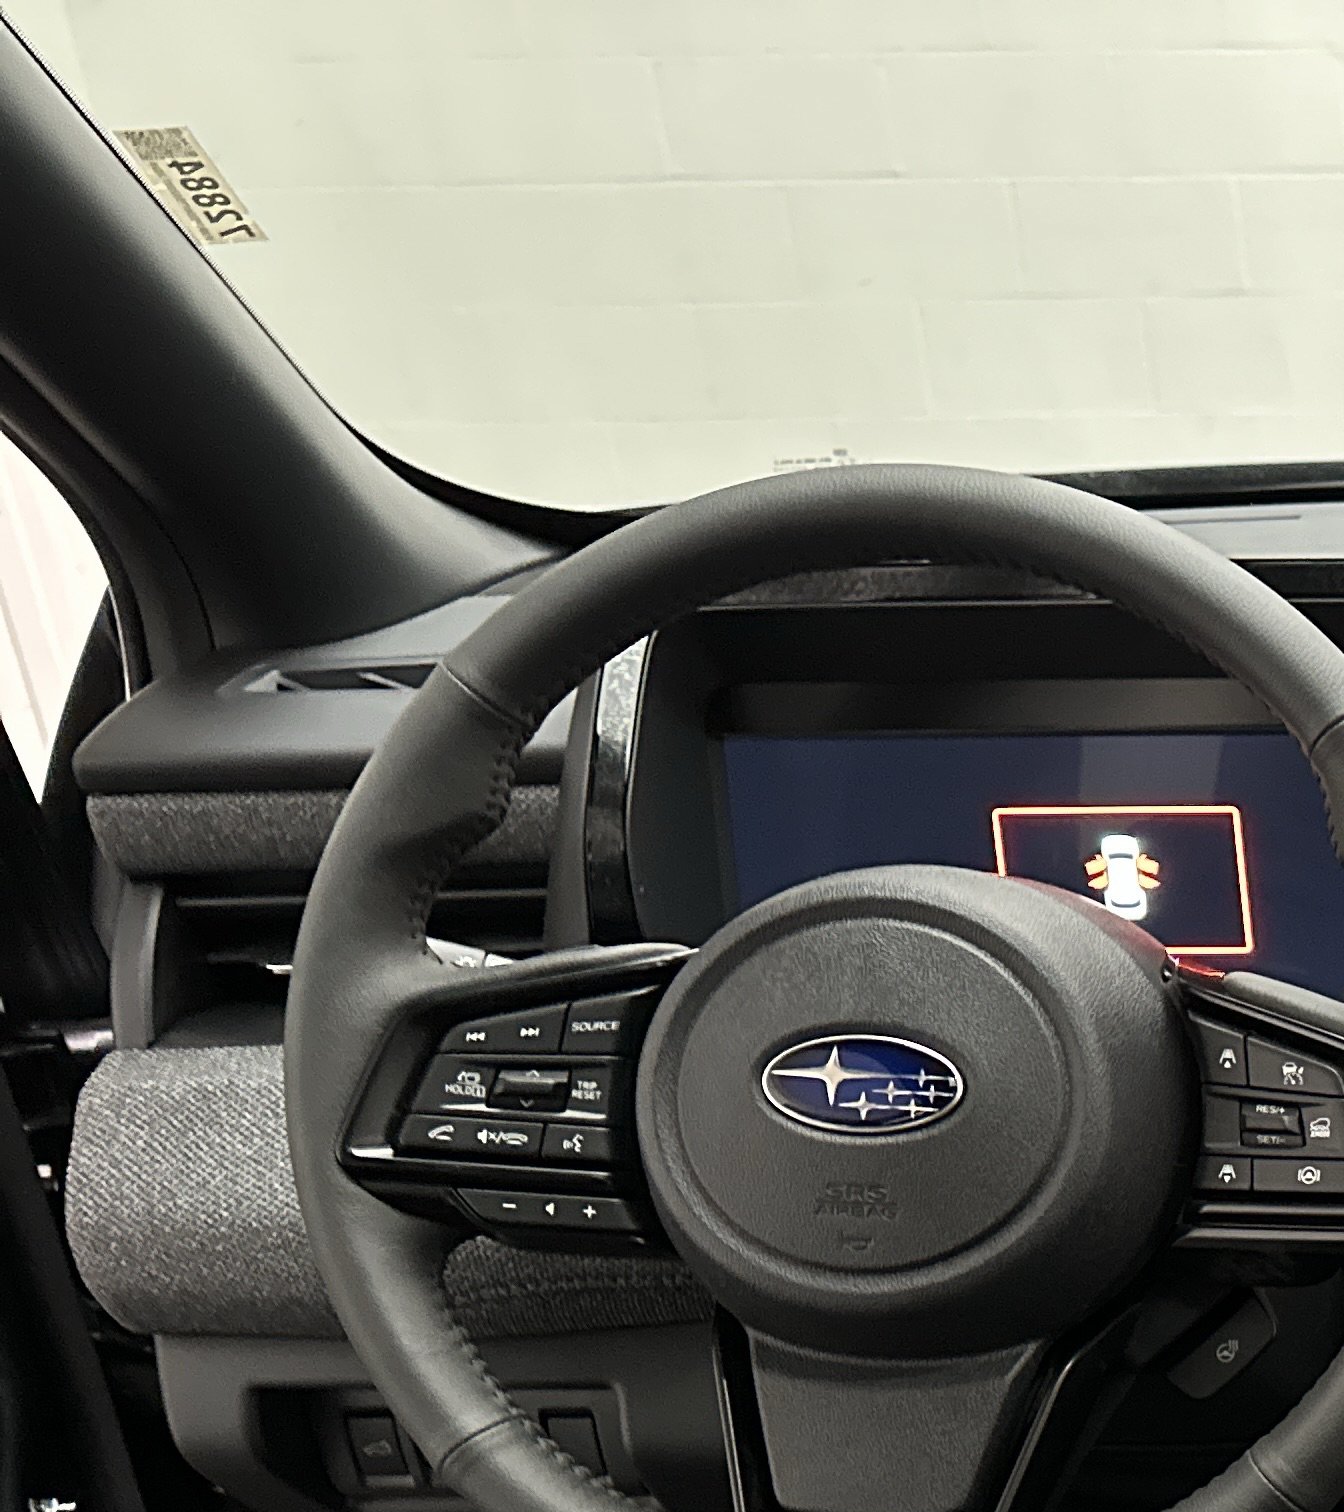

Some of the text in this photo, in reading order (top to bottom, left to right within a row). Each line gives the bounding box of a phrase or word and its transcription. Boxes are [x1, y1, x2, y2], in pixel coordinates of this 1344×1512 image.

[571, 1021, 620, 1032] SOURCE
[571, 1090, 602, 1100] RESET
[825, 1182, 889, 1200] SRS
